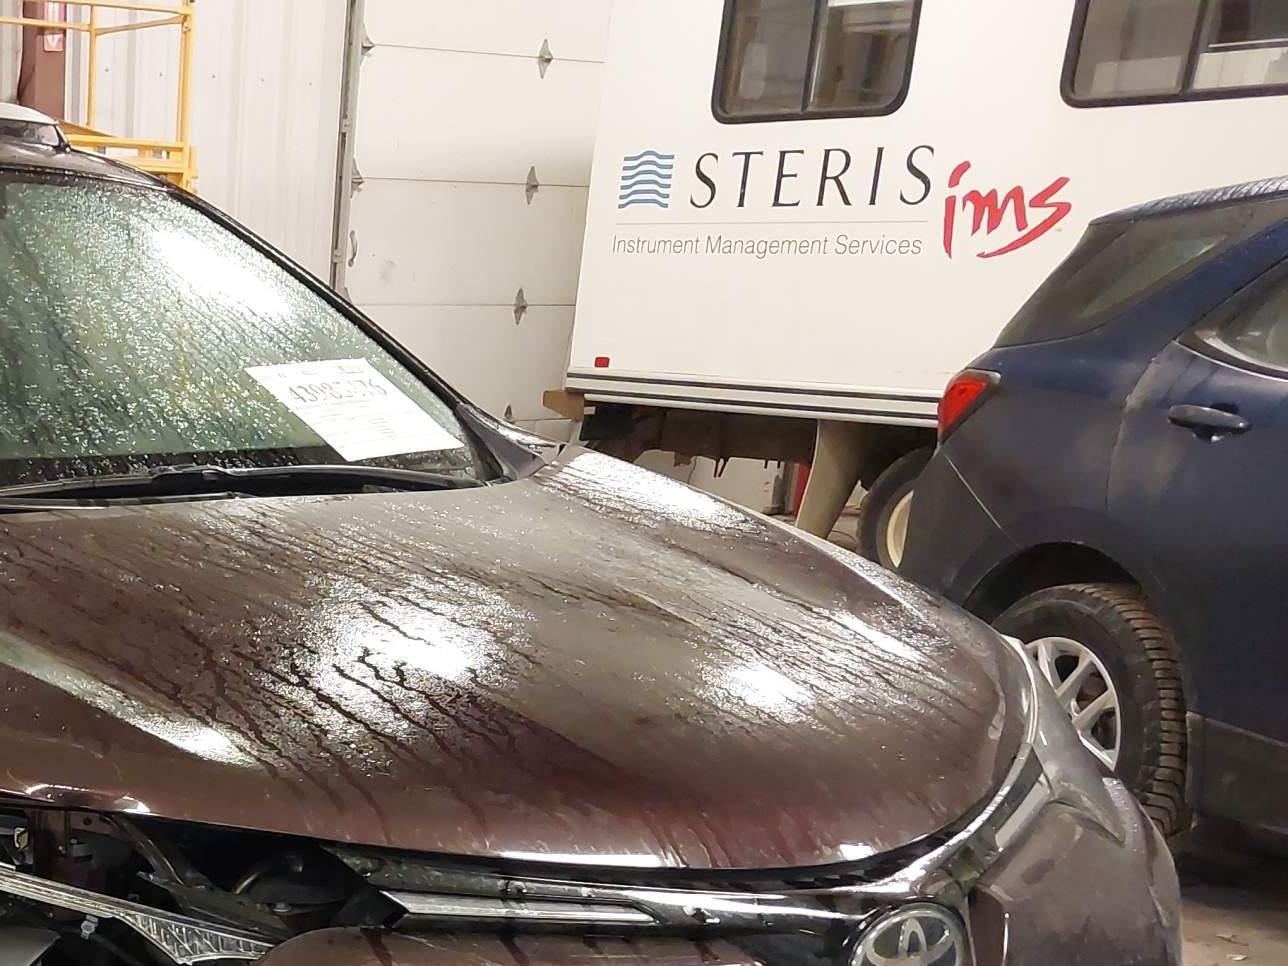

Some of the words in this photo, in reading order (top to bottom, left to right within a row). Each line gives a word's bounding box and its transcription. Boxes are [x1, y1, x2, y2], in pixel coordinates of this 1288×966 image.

[689, 144, 935, 209] STERIS
[943, 160, 1072, 259] ims
[612, 234, 700, 255] Instrument
[705, 234, 830, 260] Management
[834, 233, 924, 256] Services
